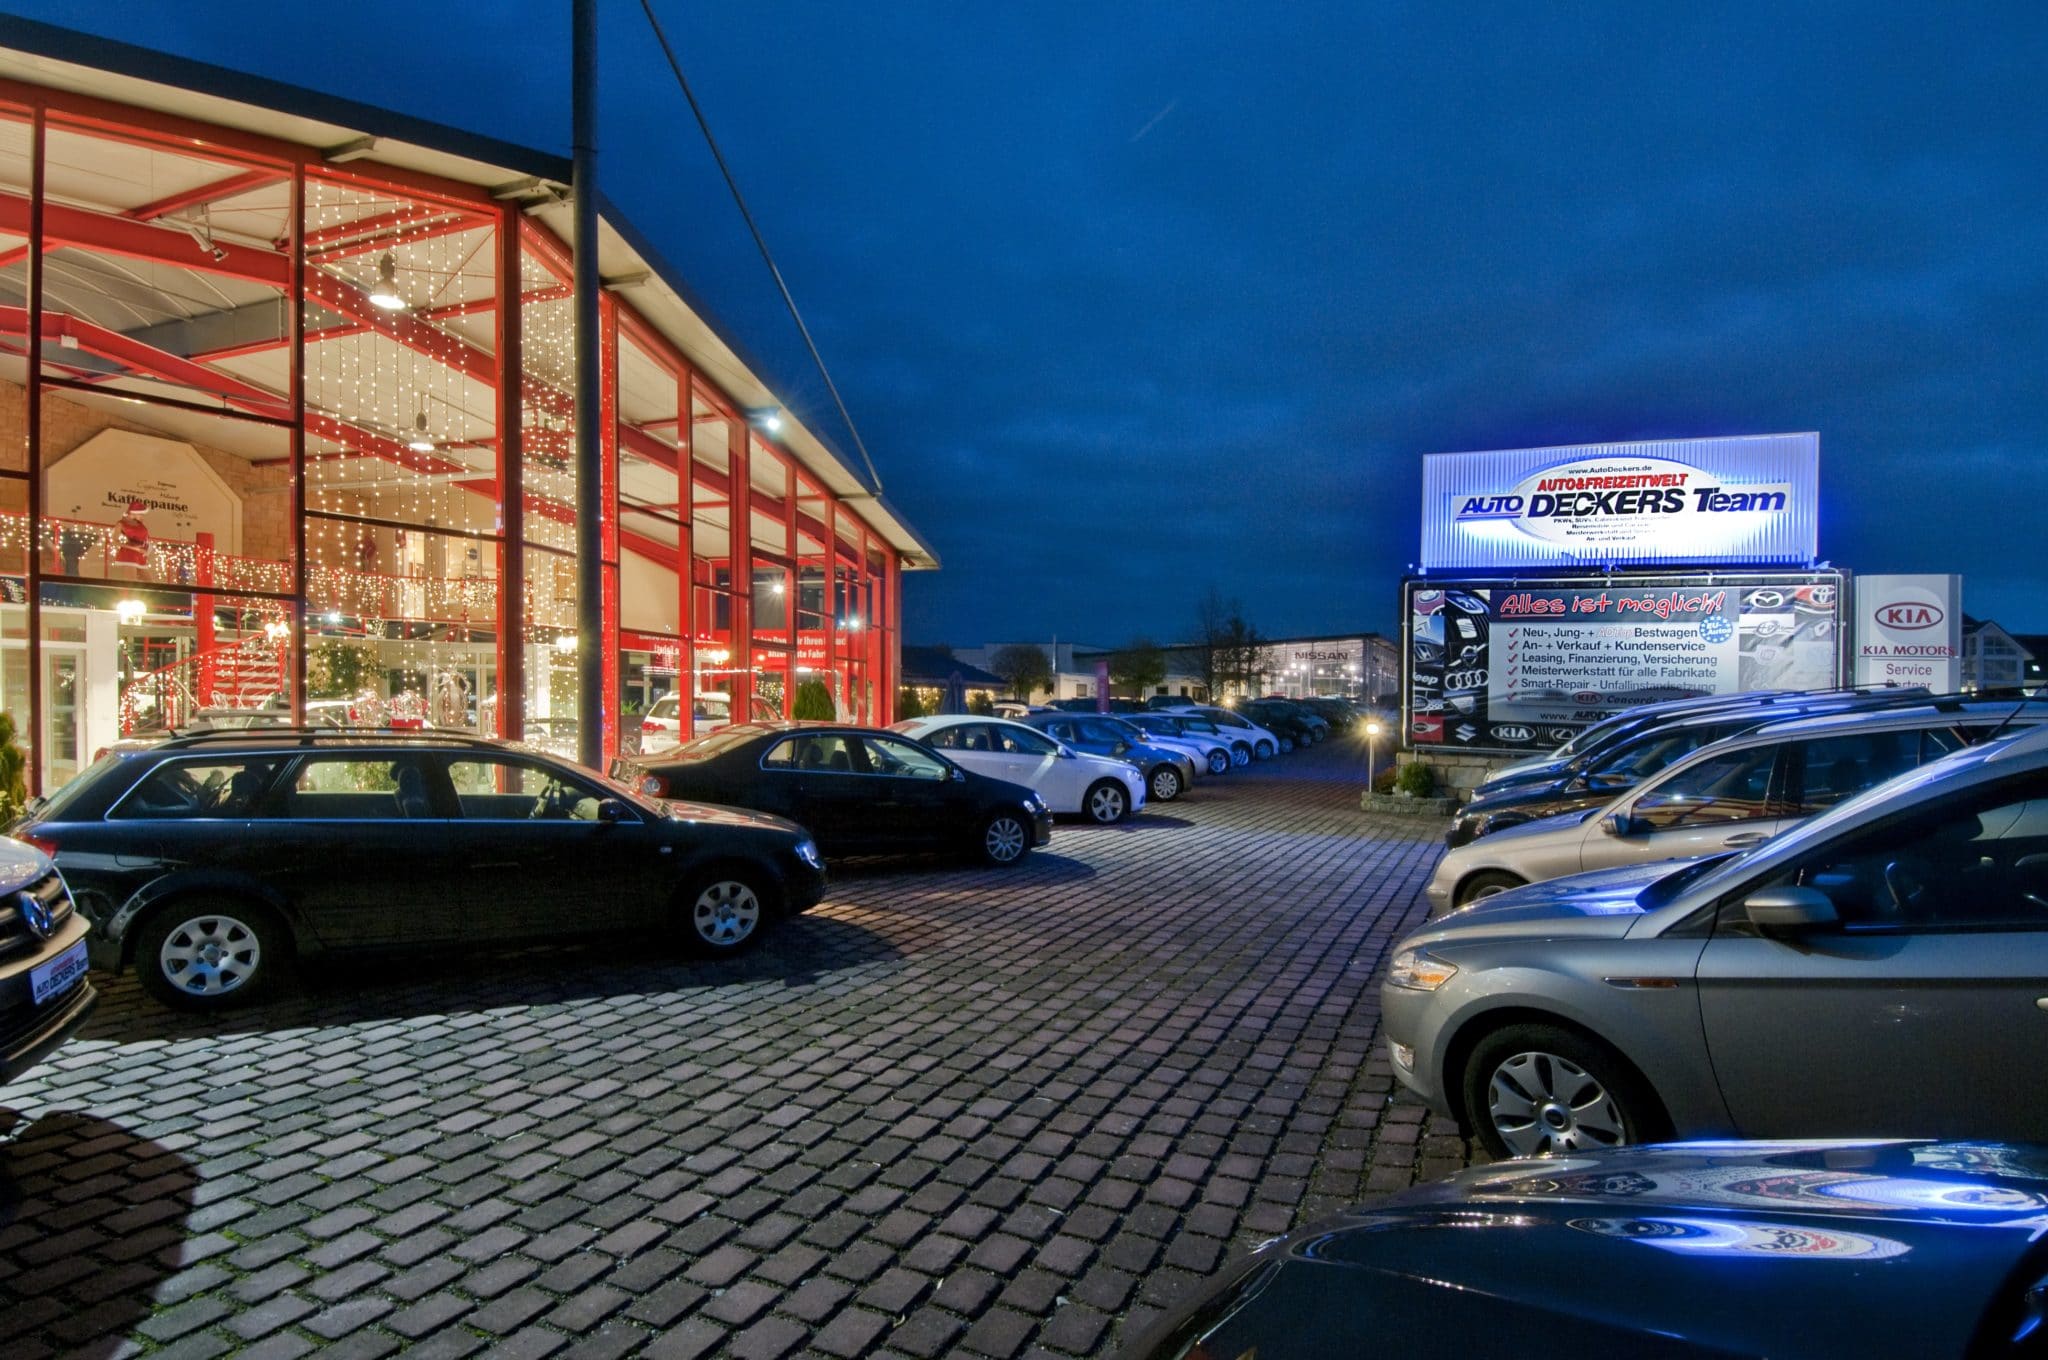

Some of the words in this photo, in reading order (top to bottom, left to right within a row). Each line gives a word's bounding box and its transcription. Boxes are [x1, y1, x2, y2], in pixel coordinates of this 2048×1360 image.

[1568, 464, 1652, 475] www.AutoDeckers.de
[1537, 473, 1688, 491] AUTO&FREIZEITWELT
[1460, 495, 1524, 514] AUTO
[1527, 488, 1686, 519] DECKERS
[1693, 487, 1786, 513] Team
[1500, 593, 1566, 615] Alles
[1571, 592, 1614, 613] ist
[1616, 591, 1727, 619] möglich!
[1888, 609, 1932, 623] KIA
[1523, 628, 1551, 639] Neu-,
[1554, 628, 1585, 640] Jung-
[1634, 628, 1698, 640] Bestwagen
[1522, 641, 1543, 650] An-
[1556, 640, 1601, 651] Verkauf
[1615, 640, 1706, 651] Kundenservice
[1863, 646, 1888, 655] KIA
[1893, 646, 1955, 656] MOTORS
[1295, 652, 1348, 660] NISSAN
[1522, 654, 1566, 666] Leasing,
[1568, 654, 1641, 666] Finanzierung,
[1644, 654, 1718, 667] Versicherung
[1521, 666, 1616, 677] Meisterwerkstatt
[1618, 666, 1634, 677] für
[1637, 666, 1658, 677] alle
[1660, 667, 1717, 678] Fabrikate
[1886, 663, 1933, 676] Service
[1521, 678, 1590, 690] Smart-Repair
[1600, 679, 1717, 693] Unfallinstandsetzung
[1577, 694, 1597, 702] KIA
[1499, 727, 1529, 738] KIA
